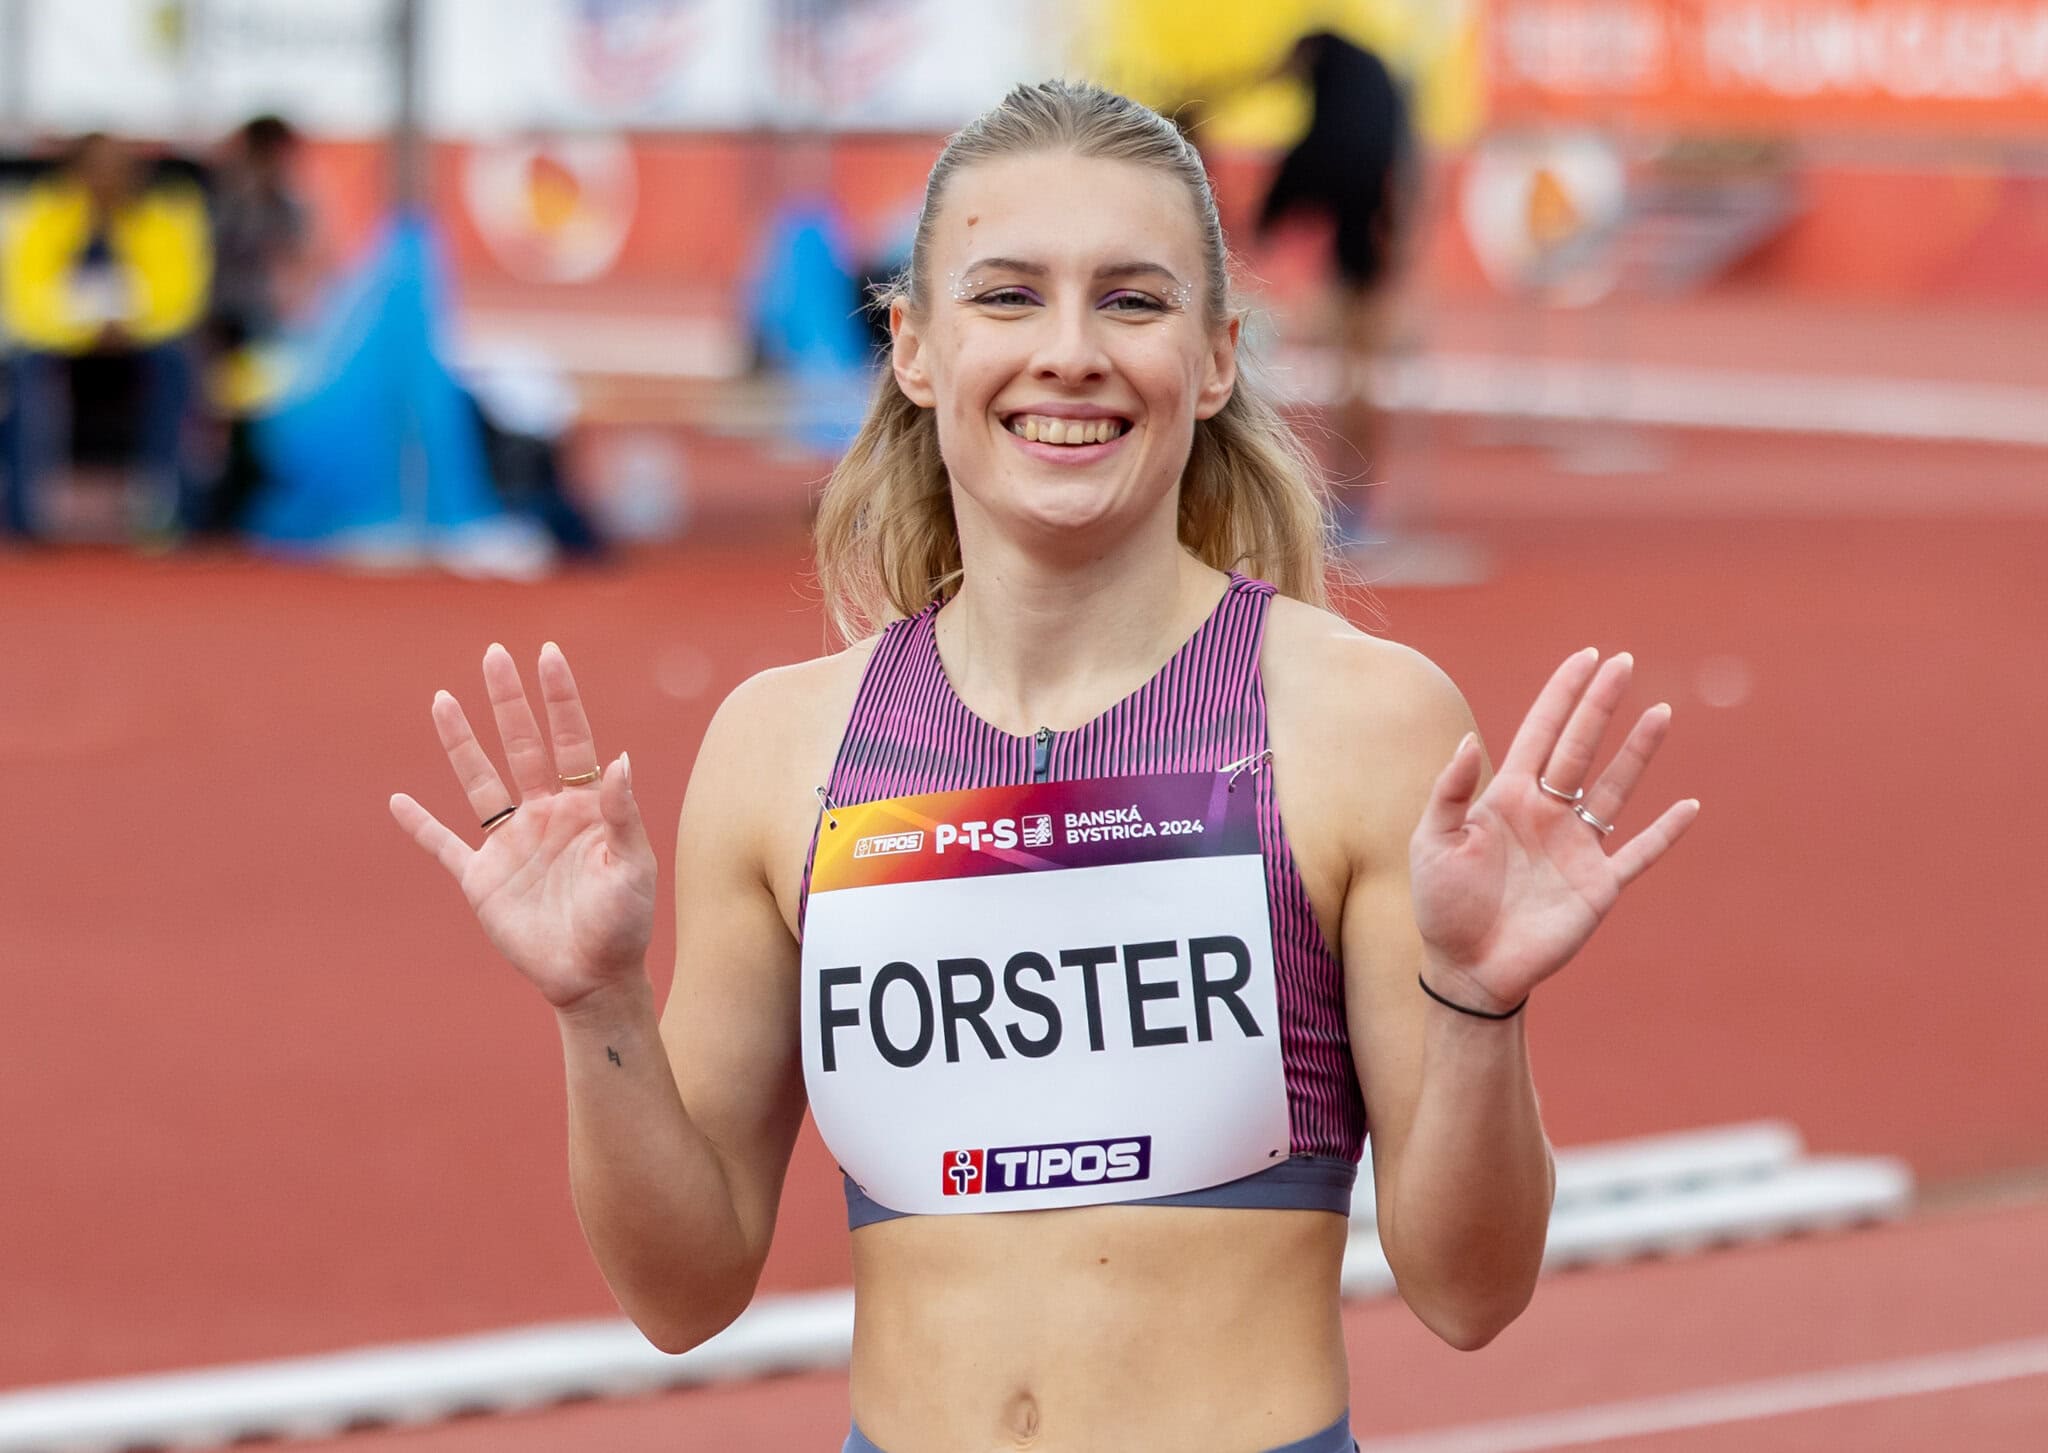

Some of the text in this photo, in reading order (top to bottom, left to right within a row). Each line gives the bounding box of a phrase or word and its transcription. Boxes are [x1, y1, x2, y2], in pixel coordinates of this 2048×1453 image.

[1064, 804, 1142, 828] BANSKÁ
[873, 835, 919, 853] TIPOS
[935, 818, 1018, 854] P-T-S
[1066, 819, 1204, 844] BYSTRICA 2024
[819, 935, 1264, 1072] FORSTER
[994, 1141, 1142, 1187] TIPOS
